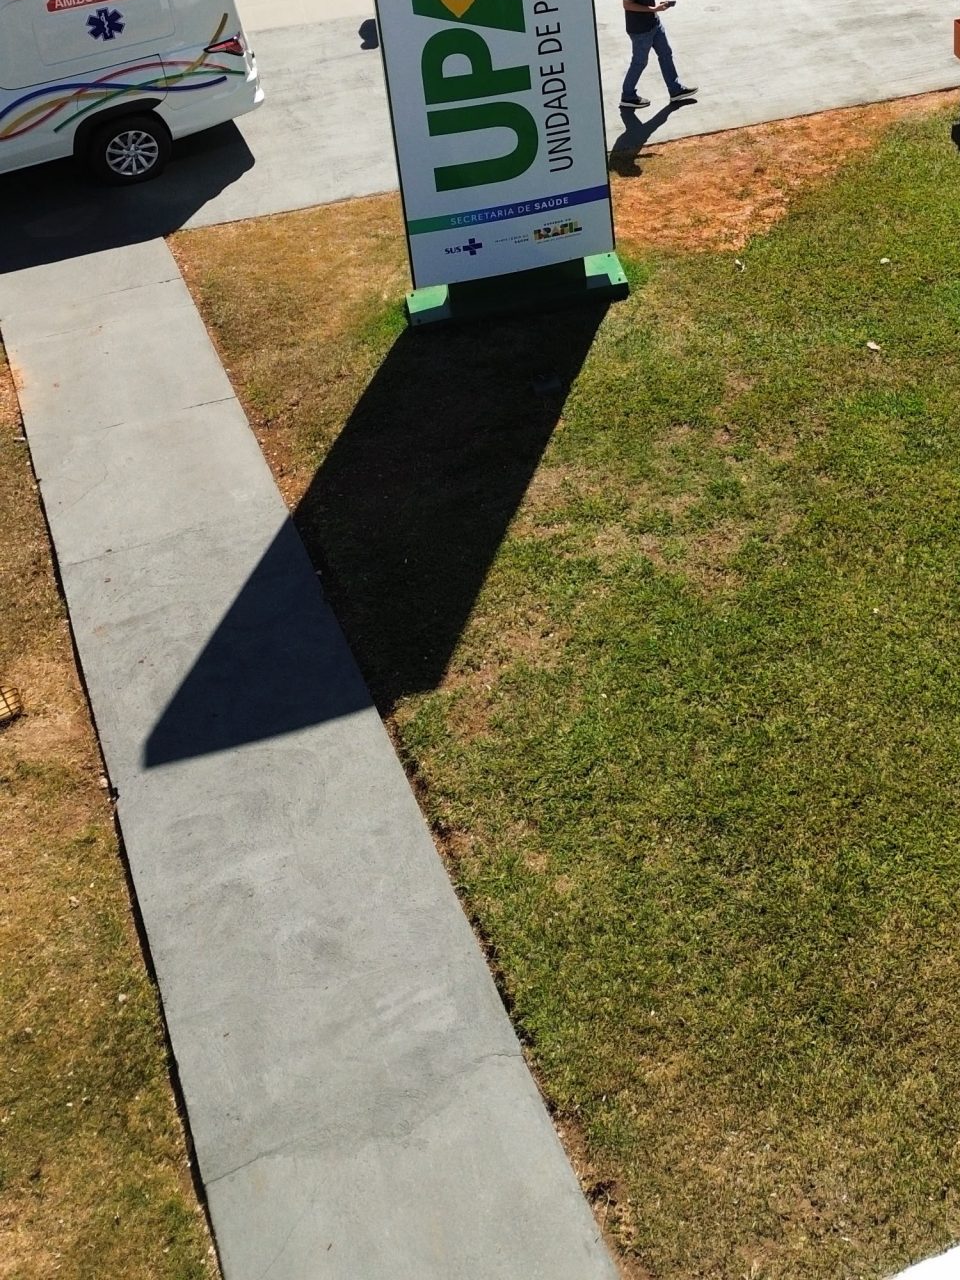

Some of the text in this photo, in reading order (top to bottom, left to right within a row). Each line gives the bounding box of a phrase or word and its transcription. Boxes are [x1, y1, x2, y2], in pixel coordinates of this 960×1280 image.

[536, 22, 563, 55] DE
[540, 62, 574, 173] UNIDADE
[450, 197, 569, 225] SECRETARIA DE SAÚDE
[444, 246, 462, 255] SUS
